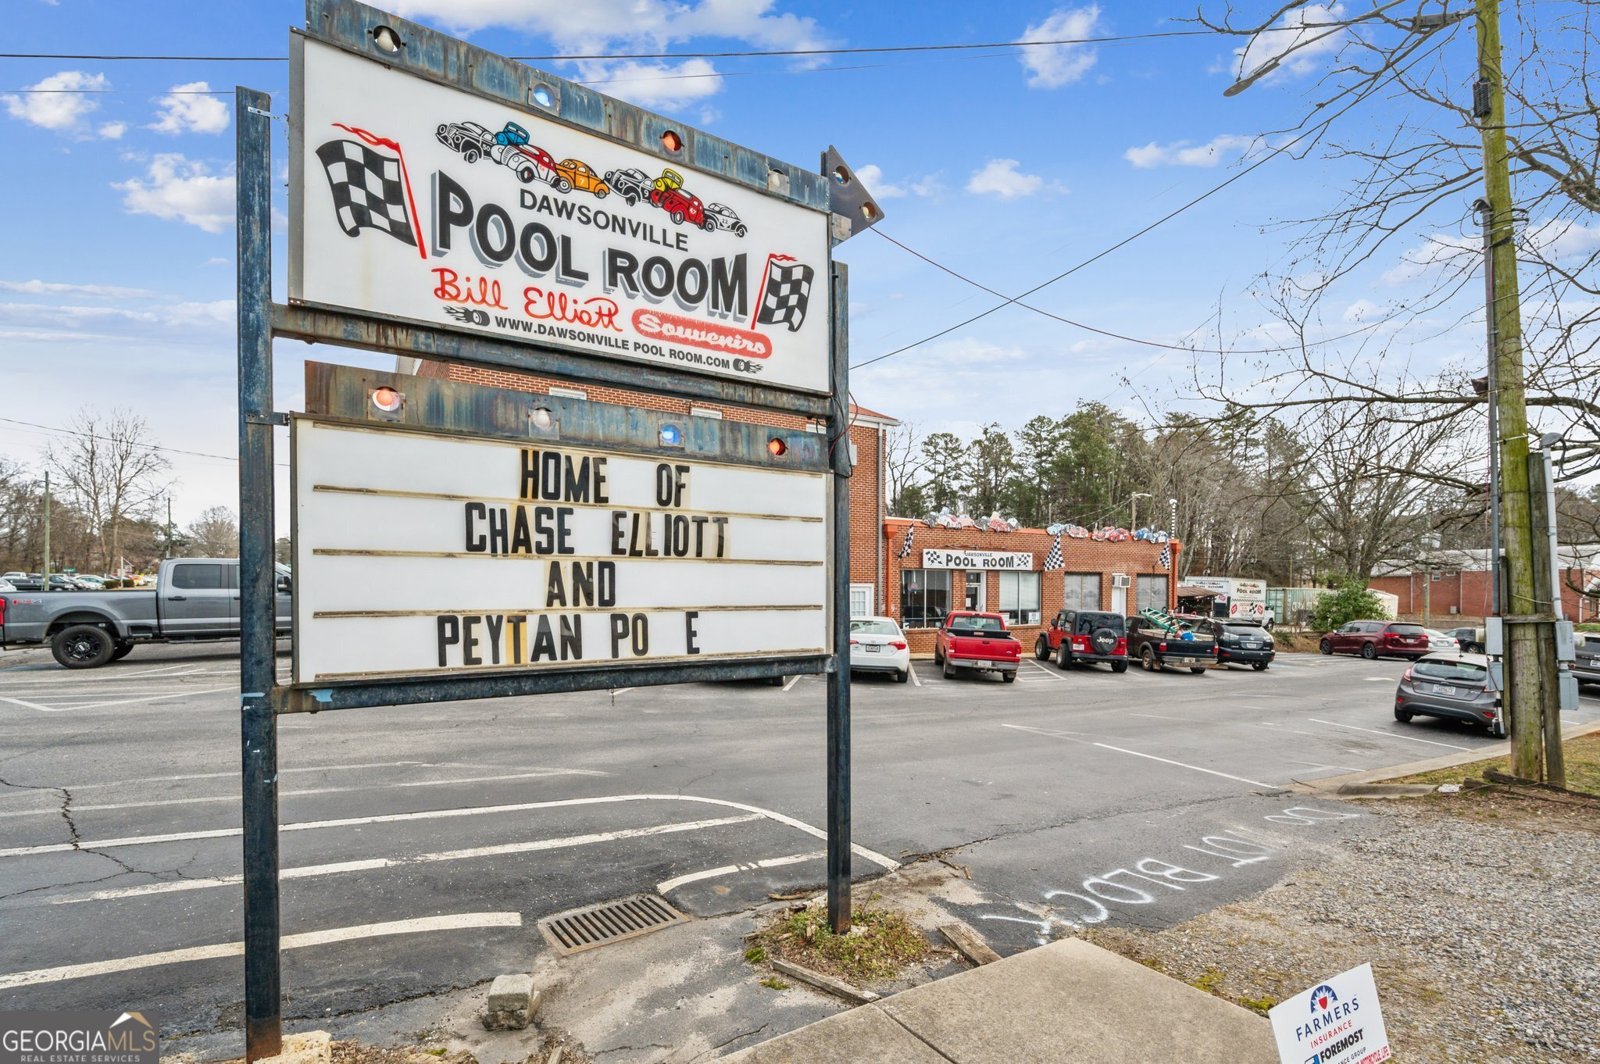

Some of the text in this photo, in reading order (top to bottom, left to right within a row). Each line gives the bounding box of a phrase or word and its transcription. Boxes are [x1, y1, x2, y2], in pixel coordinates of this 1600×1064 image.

[643, 189, 649, 198] 9
[520, 188, 688, 252] DAWSONVILLE
[431, 170, 748, 322] POOL ROOM
[431, 267, 508, 310] Bill
[494, 316, 730, 369] WWW.DAWSONVILLE POOL ROOM.COM
[638, 313, 766, 354] Souvenirs
[520, 449, 690, 507] HOME OF
[465, 502, 729, 558] CHASE ELLIOTT
[945, 553, 1014, 568] POOL ROOM
[546, 561, 616, 607] AND
[437, 614, 582, 667] PEYTAN
[1096, 636, 1114, 645] Jeep
[1296, 997, 1360, 1042] FARMERS
[1310, 1020, 1353, 1050] INSURANCE
[1320, 1028, 1364, 1064] FOREMOST
